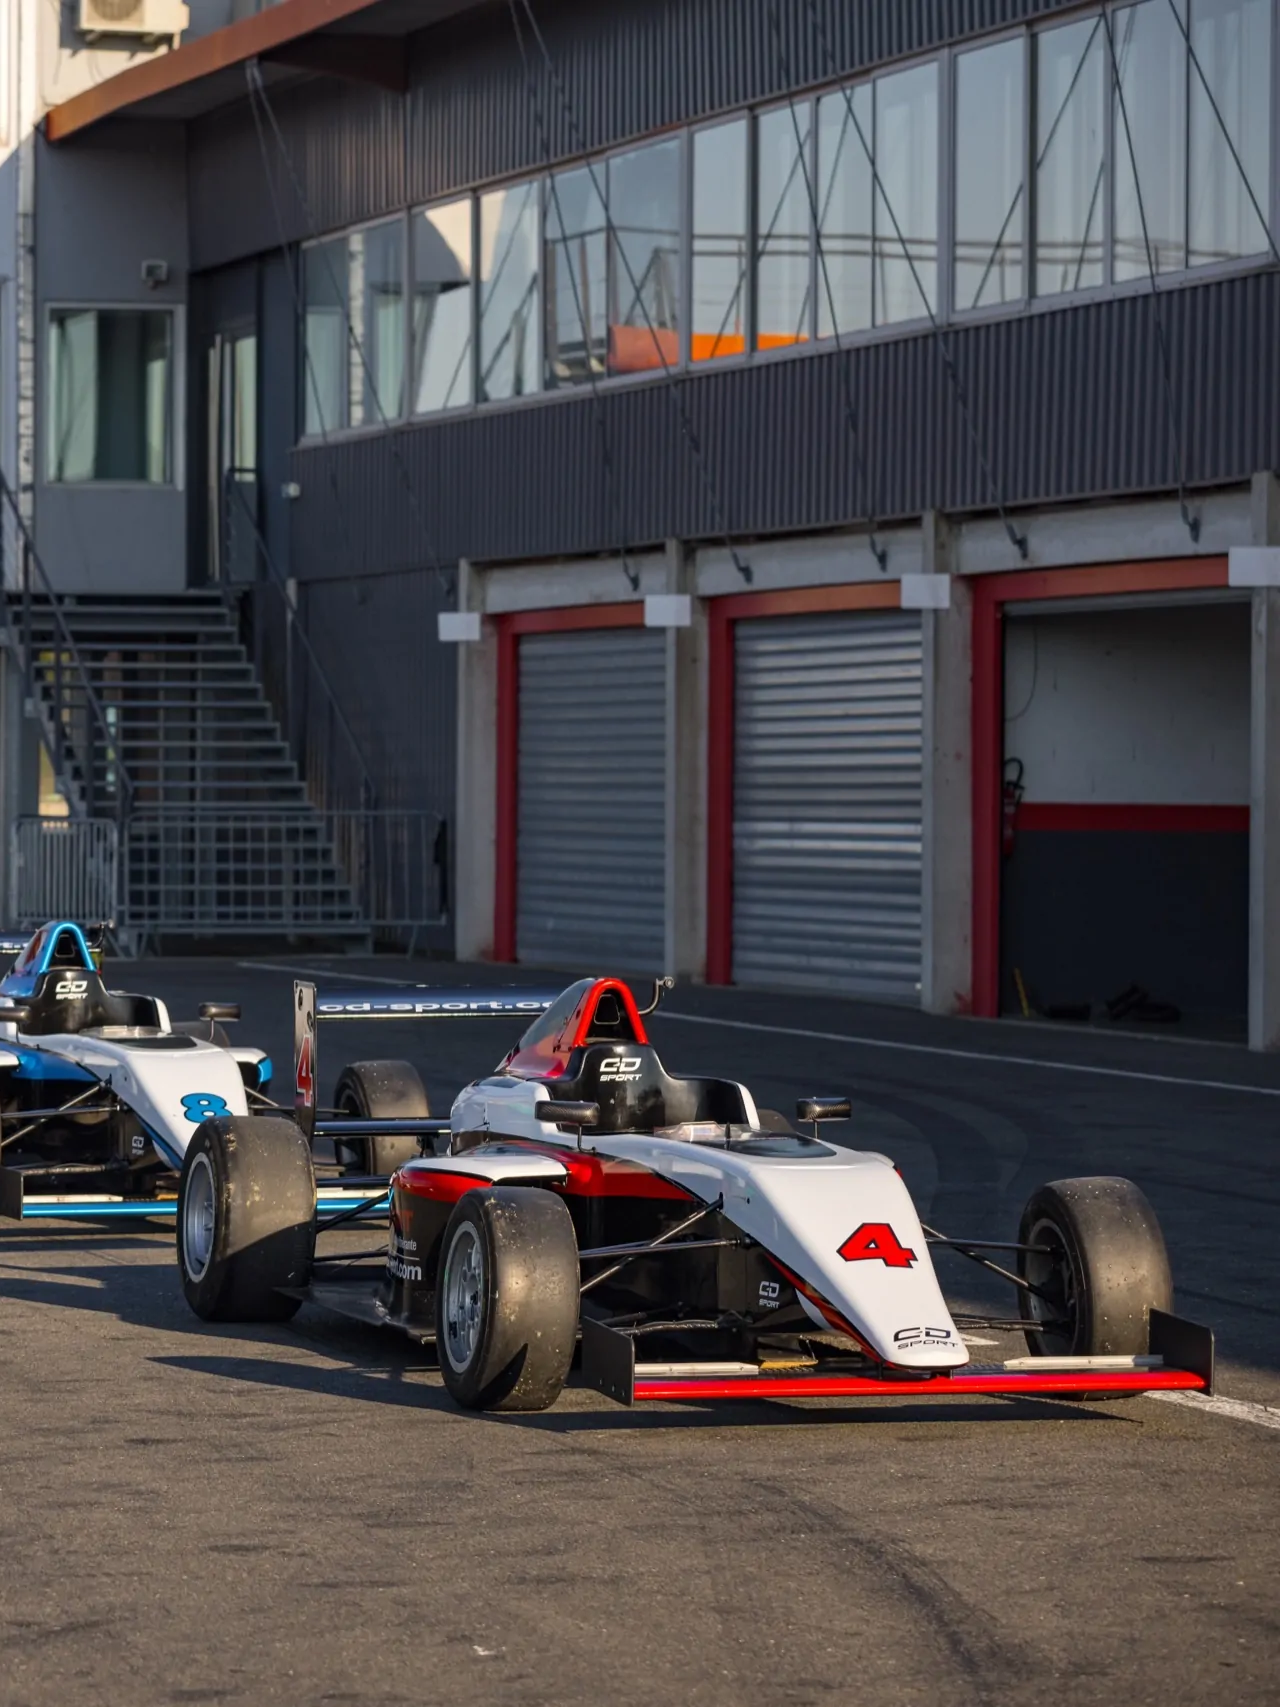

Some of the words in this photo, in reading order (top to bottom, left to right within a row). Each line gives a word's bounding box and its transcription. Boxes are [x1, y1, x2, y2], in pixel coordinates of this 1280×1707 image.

[320, 1001, 554, 1013] cd-sport.c
[296, 1034, 313, 1107] 4
[600, 1073, 642, 1082] SPORT
[180, 1092, 234, 1124] 8
[836, 1222, 919, 1269] 4
[759, 1298, 780, 1309] SPORT
[897, 1339, 958, 1350] SPORT
